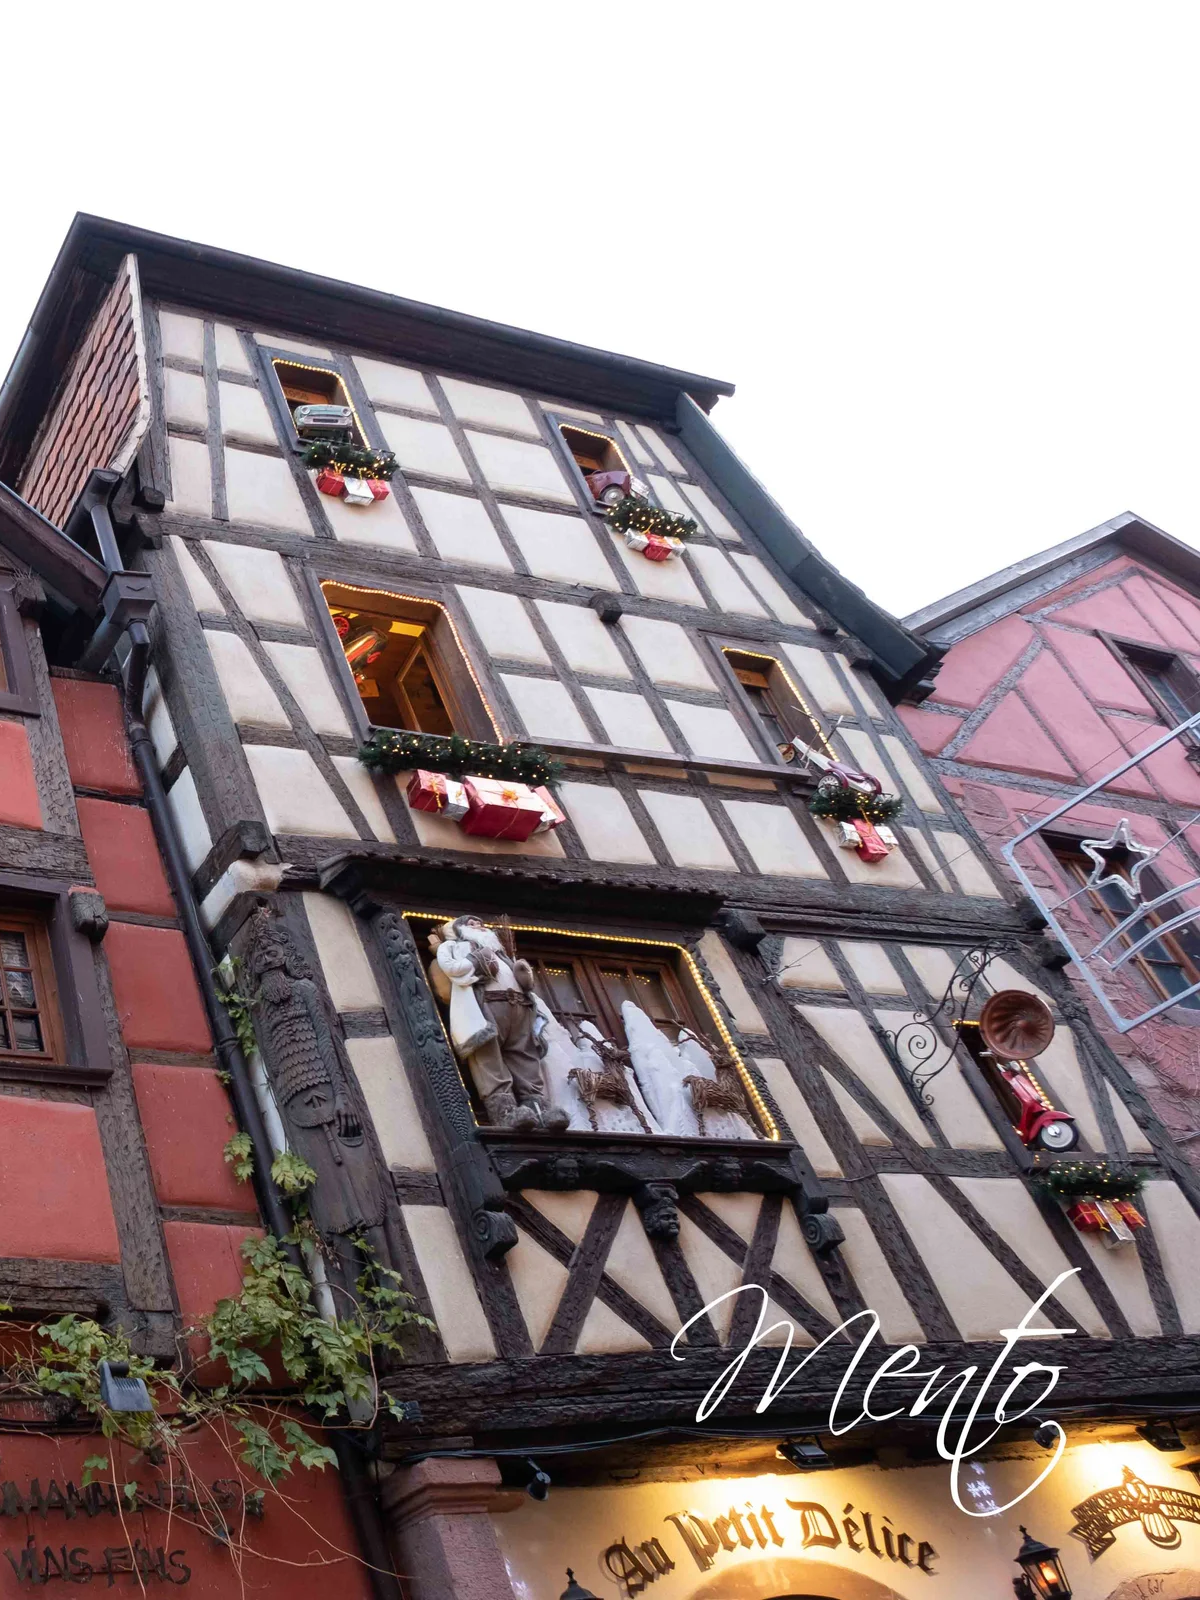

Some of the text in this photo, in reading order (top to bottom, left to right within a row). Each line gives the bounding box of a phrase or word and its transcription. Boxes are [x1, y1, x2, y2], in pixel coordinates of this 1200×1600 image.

[2, 1535, 192, 1587] VINS FINS
[605, 1498, 938, 1599] Au Petit Délice
